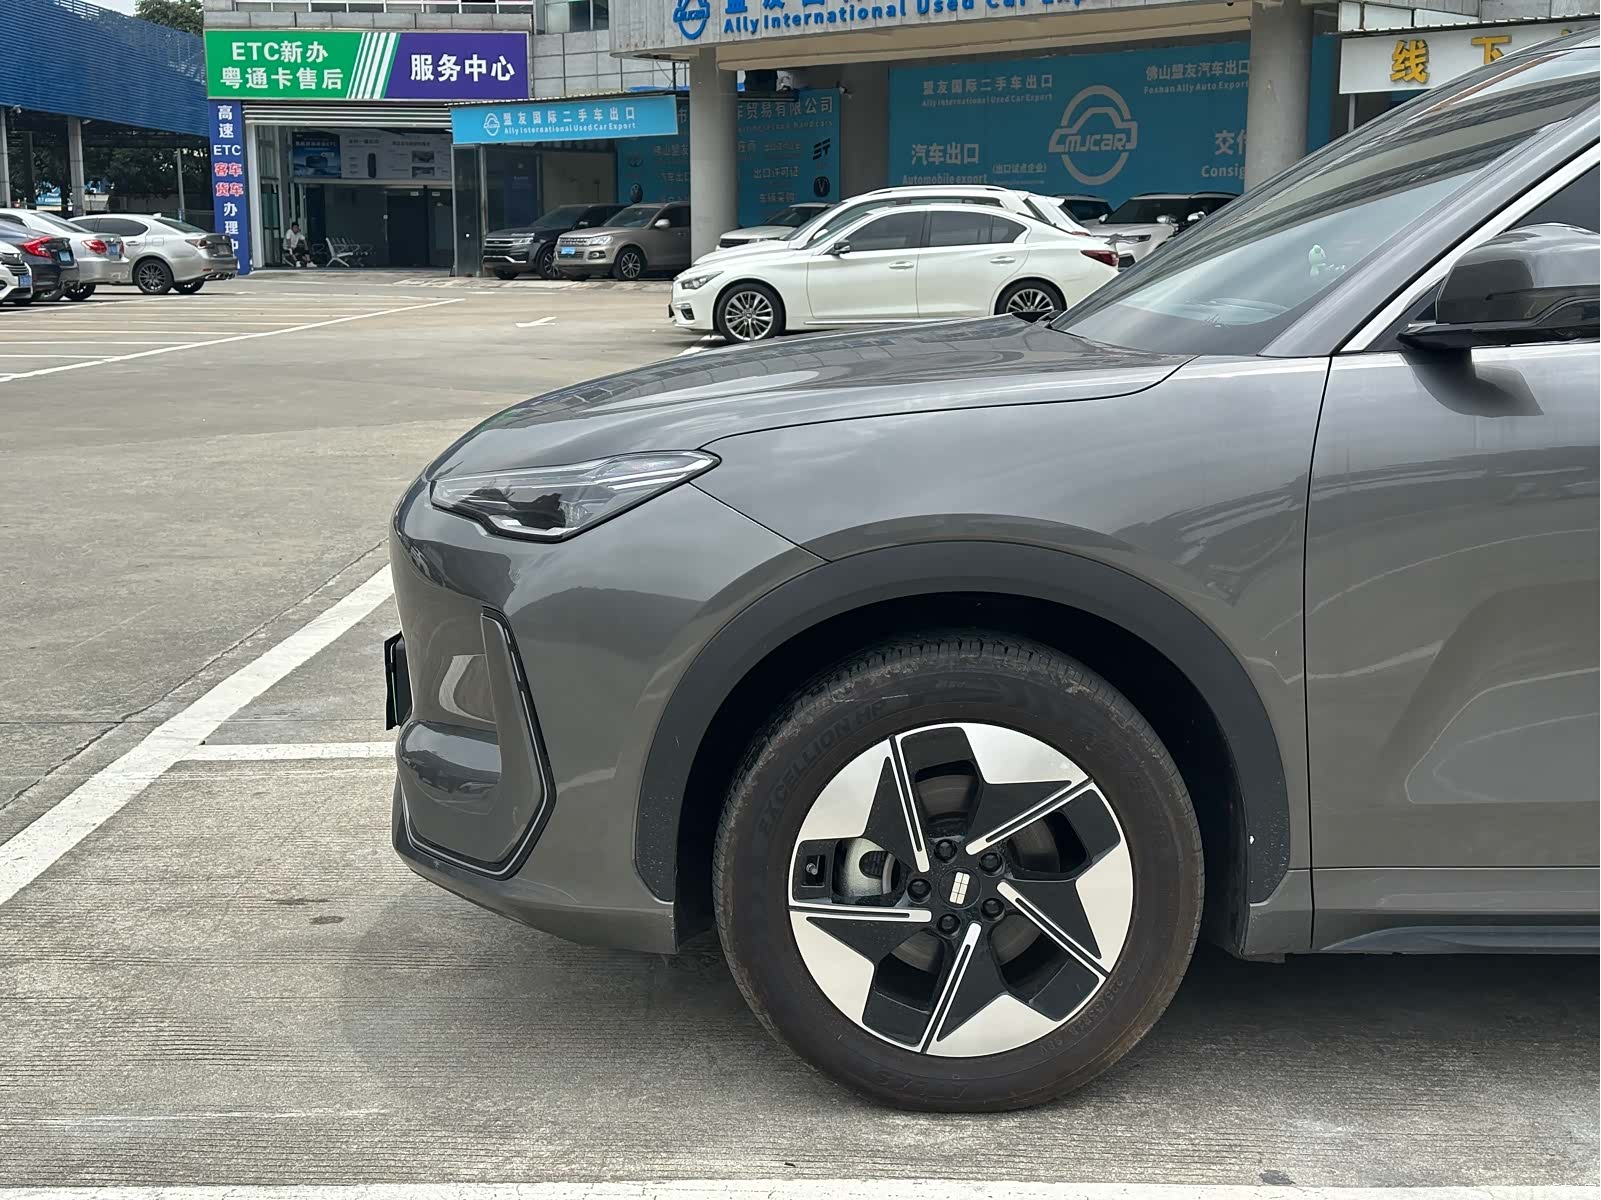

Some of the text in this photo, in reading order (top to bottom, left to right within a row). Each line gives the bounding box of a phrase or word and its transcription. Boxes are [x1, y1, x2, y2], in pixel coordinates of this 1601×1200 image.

[723, 15, 760, 35] Ally
[764, 0, 906, 30] International
[231, 41, 329, 63] ETC新办
[220, 67, 344, 90] 粤通卡售后
[410, 54, 516, 82] 服务中心
[1145, 60, 1249, 81] 佛山盟友汽车出口
[923, 74, 1053, 96] 盟友国际二手车出口
[1144, 86, 1175, 95] Foshan
[1177, 84, 1194, 94] Ally
[1195, 82, 1217, 91] Auto
[503, 106, 635, 125] 盟友国际二手车出口
[504, 121, 636, 136] Ally International Used Car Export
[911, 142, 979, 165] 汽车出口
[213, 105, 244, 269] 高速 ETC 客车 货车 办理中
[902, 174, 954, 185] Automobile
